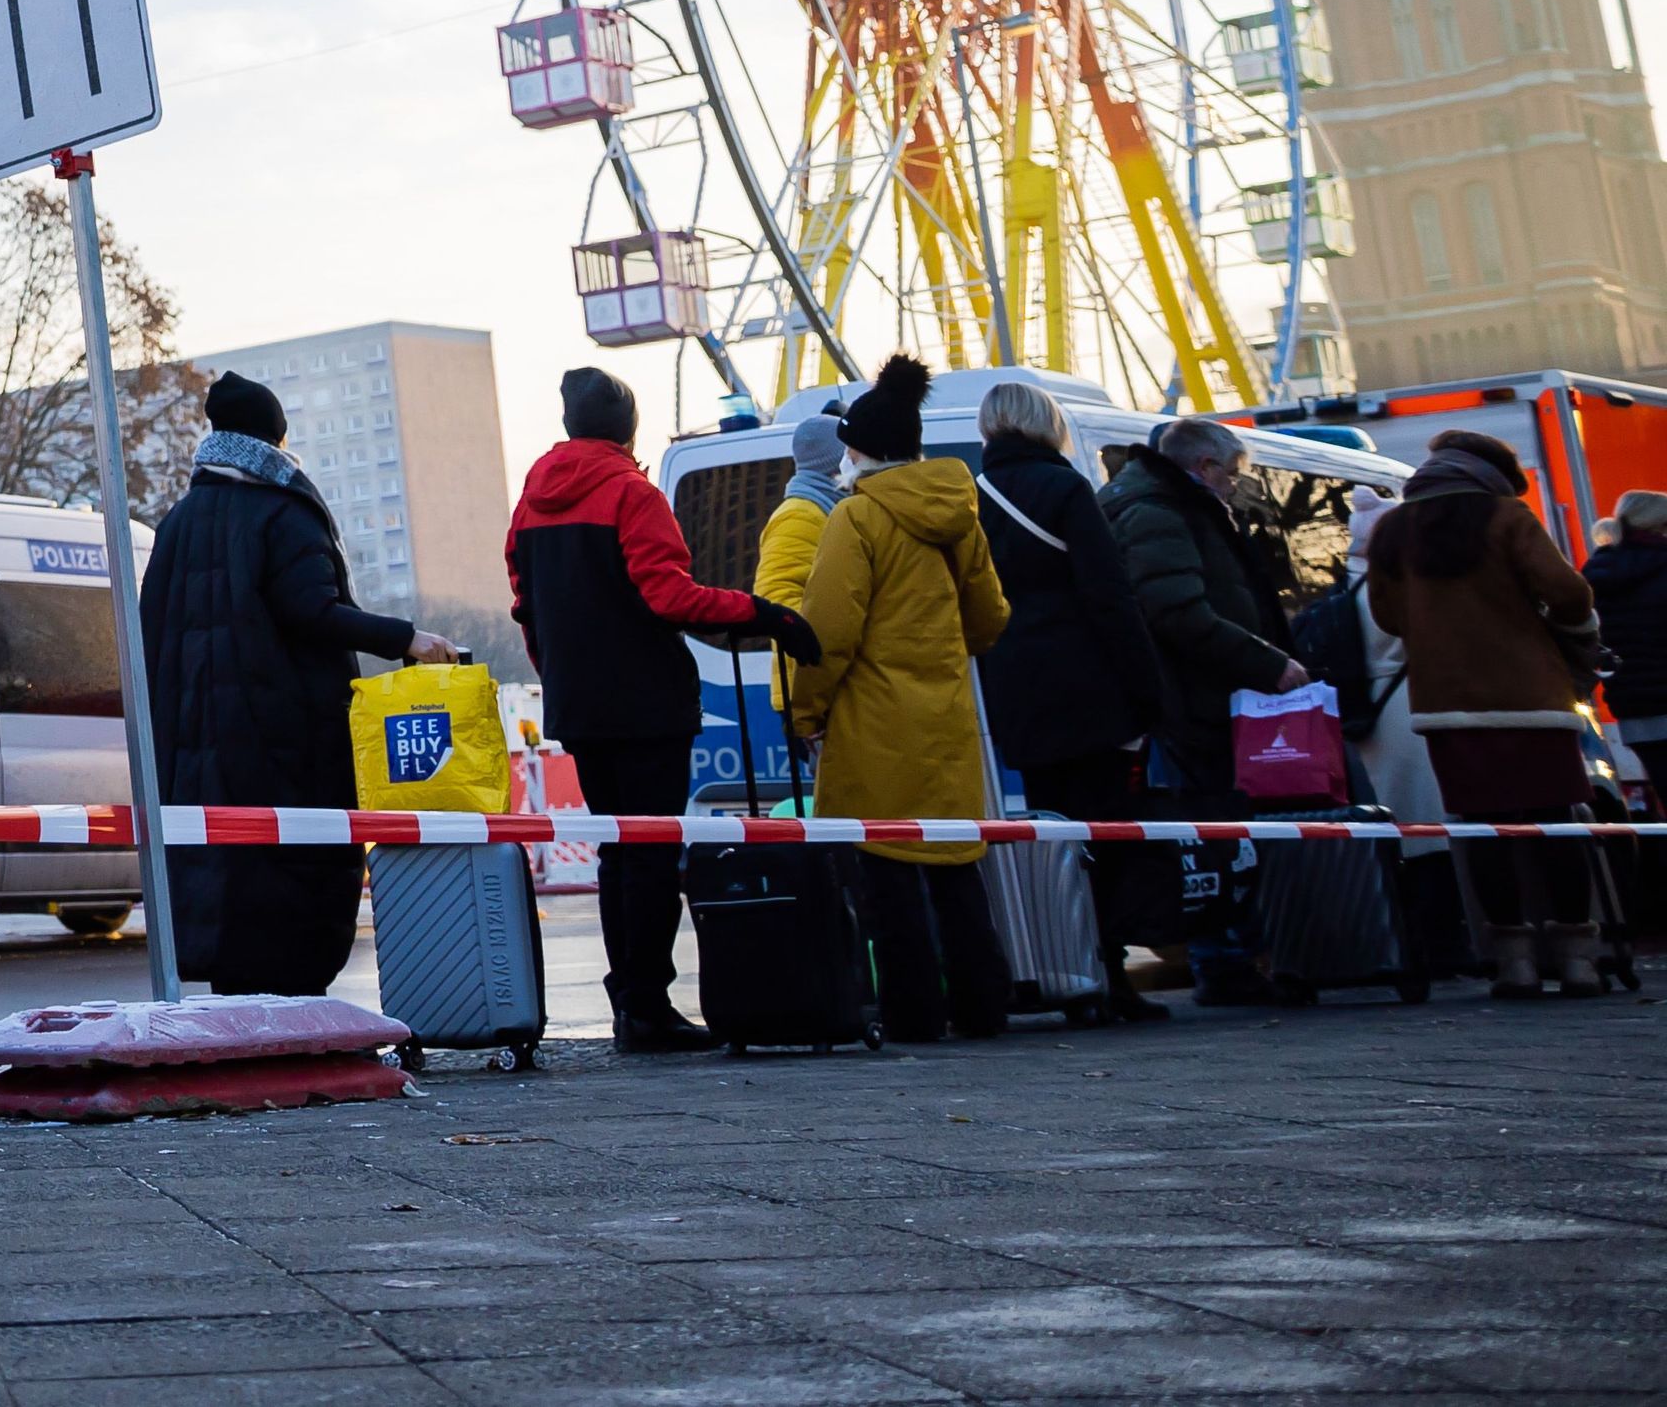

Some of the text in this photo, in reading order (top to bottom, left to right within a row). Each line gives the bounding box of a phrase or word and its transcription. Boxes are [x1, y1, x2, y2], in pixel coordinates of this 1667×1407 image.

[30, 545, 108, 571] POLIZEI
[396, 718, 439, 737] SEE
[397, 736, 442, 756] BUY
[491, 954, 514, 1008] ISAAC
